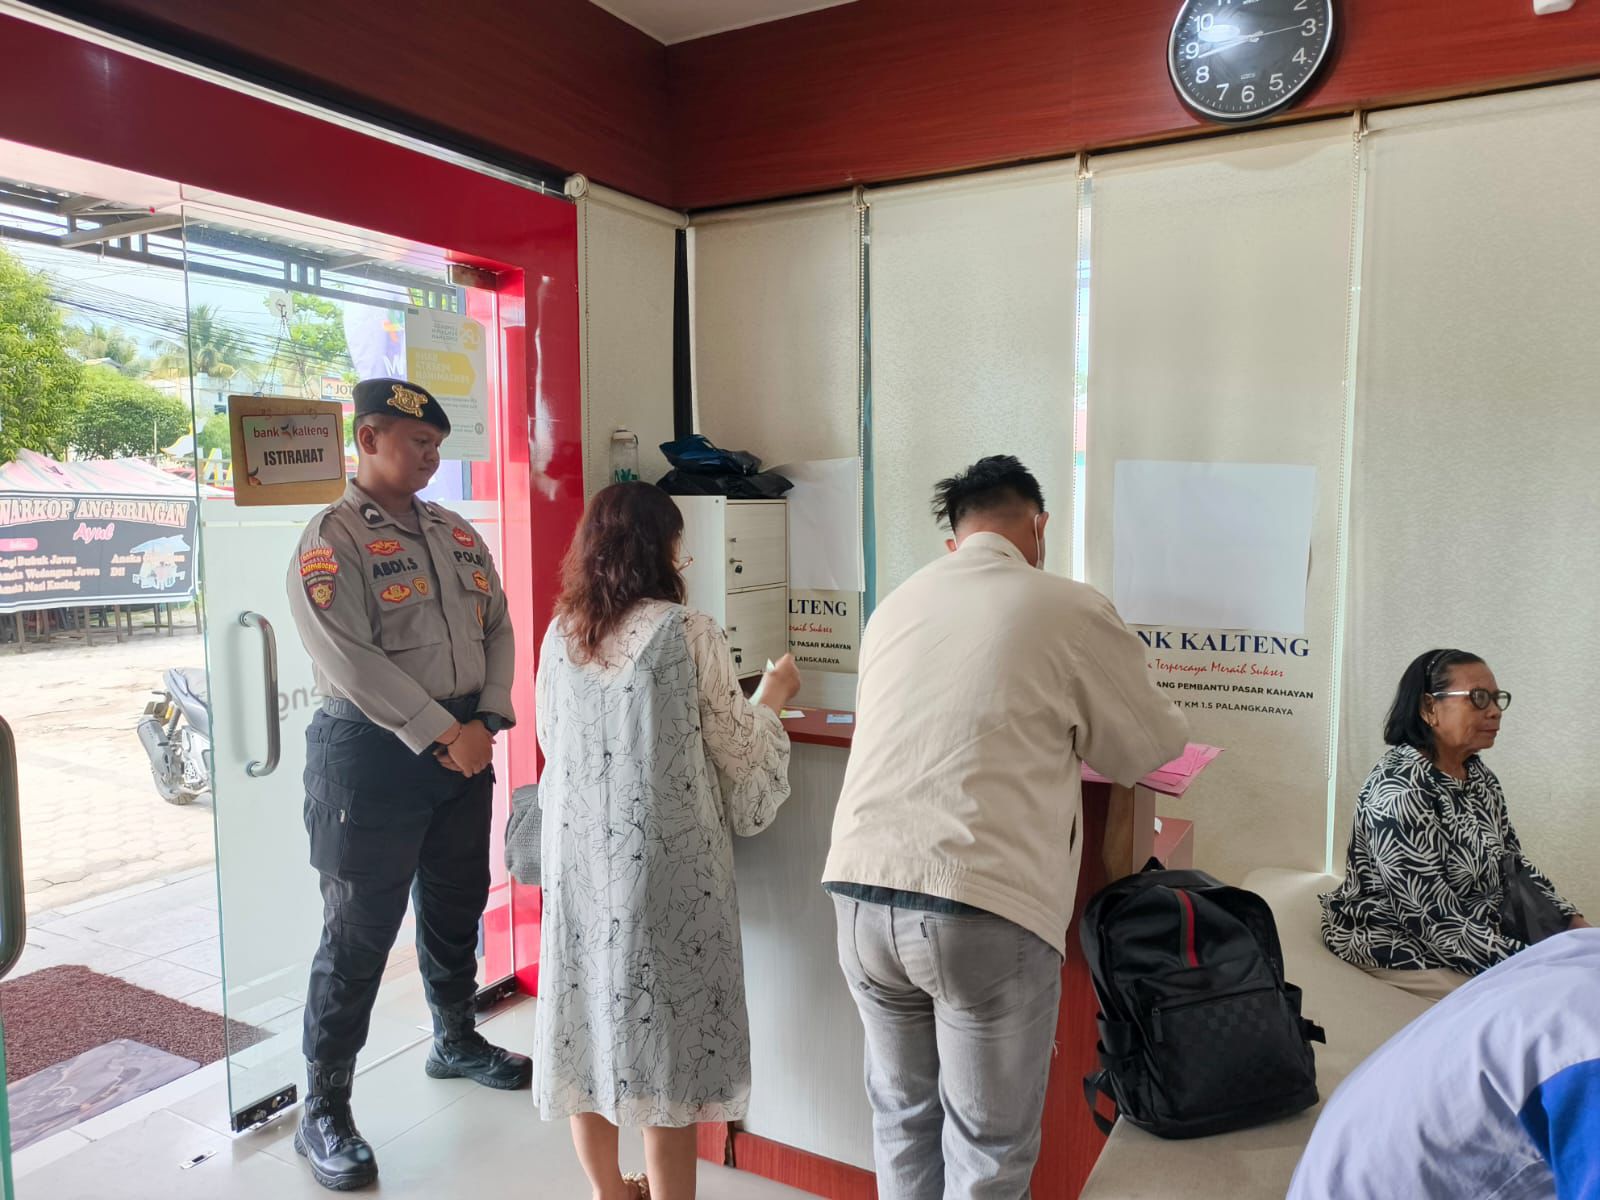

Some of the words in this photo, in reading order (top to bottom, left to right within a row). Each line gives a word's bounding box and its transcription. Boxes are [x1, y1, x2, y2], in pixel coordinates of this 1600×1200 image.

[1194, 13, 1214, 32] 10
[1301, 18, 1316, 37] 3
[1186, 42, 1200, 60] 9
[1292, 47, 1307, 65] 4
[1195, 65, 1210, 84] 8
[1269, 73, 1283, 91] 5
[1216, 83, 1229, 101] 7
[1241, 85, 1255, 103] 6
[253, 427, 279, 438] bank
[292, 426, 329, 438] kalteng
[263, 448, 324, 466] ISTIRAHAT
[75, 498, 190, 529] ANGKRINGAN
[821, 642, 851, 651] KAHAYAN
[1180, 632, 1309, 657] KALTENG
[1155, 659, 1208, 676] Terpercaya
[1211, 661, 1248, 675] Meraih
[1250, 663, 1286, 678] Sukses
[1177, 682, 1230, 692] PEMBANTU
[1232, 685, 1264, 694] PASAR
[1266, 688, 1314, 699] KAHAYAN
[1215, 703, 1293, 716] PALANGKARAYA
